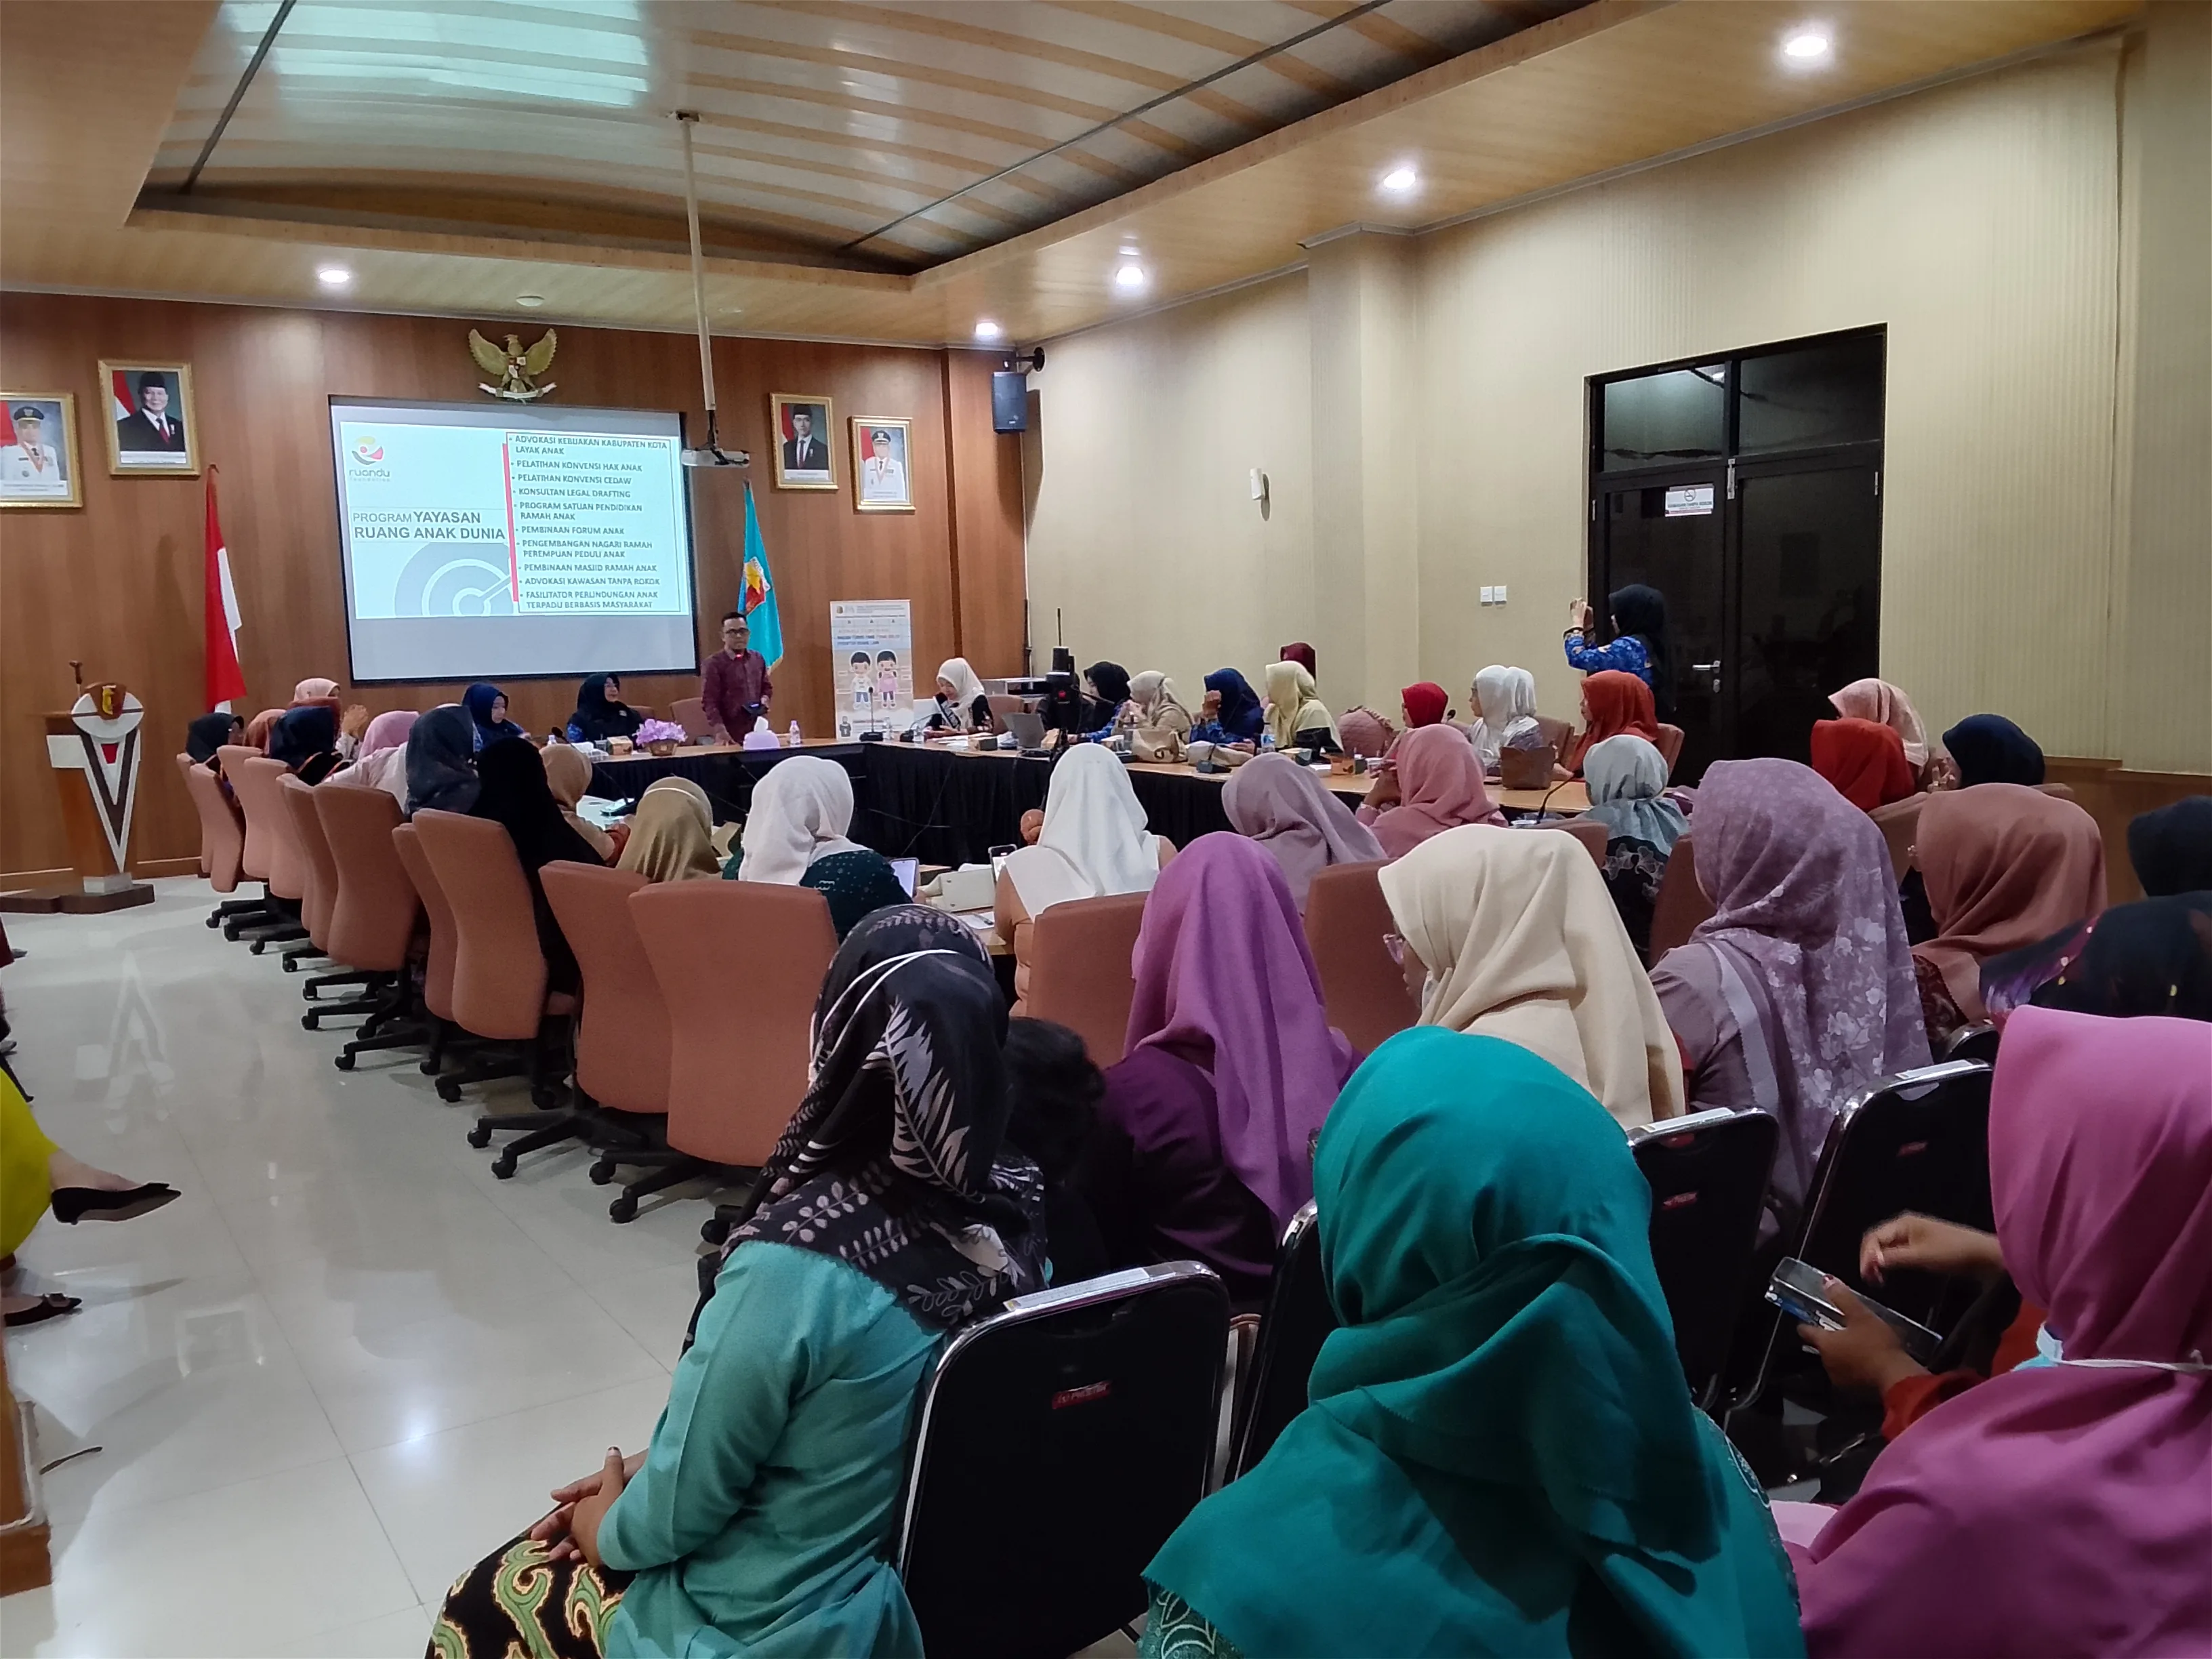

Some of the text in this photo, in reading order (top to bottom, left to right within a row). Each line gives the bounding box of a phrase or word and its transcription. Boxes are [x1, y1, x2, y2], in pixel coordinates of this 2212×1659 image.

[515, 435, 556, 444] ADVOKASI
[602, 440, 645, 448] KABUPATEN
[516, 446, 539, 454] LAYAK
[516, 460, 560, 468] PELATIHAN
[562, 462, 601, 470] KONVENSI
[518, 474, 632, 485] PELATIHAN KONVENSI CEDAW
[519, 488, 565, 496] KONSULTAN
[592, 490, 631, 498] DRAFTING
[520, 501, 561, 510] PROGRAM
[596, 504, 642, 512] PENDIDIKAN
[353, 511, 480, 524] PROGRAM YAYASAN
[553, 512, 576, 520] ANAK
[354, 527, 506, 539] RUANG ANAK DUNIA
[607, 577, 632, 586] TANPA
